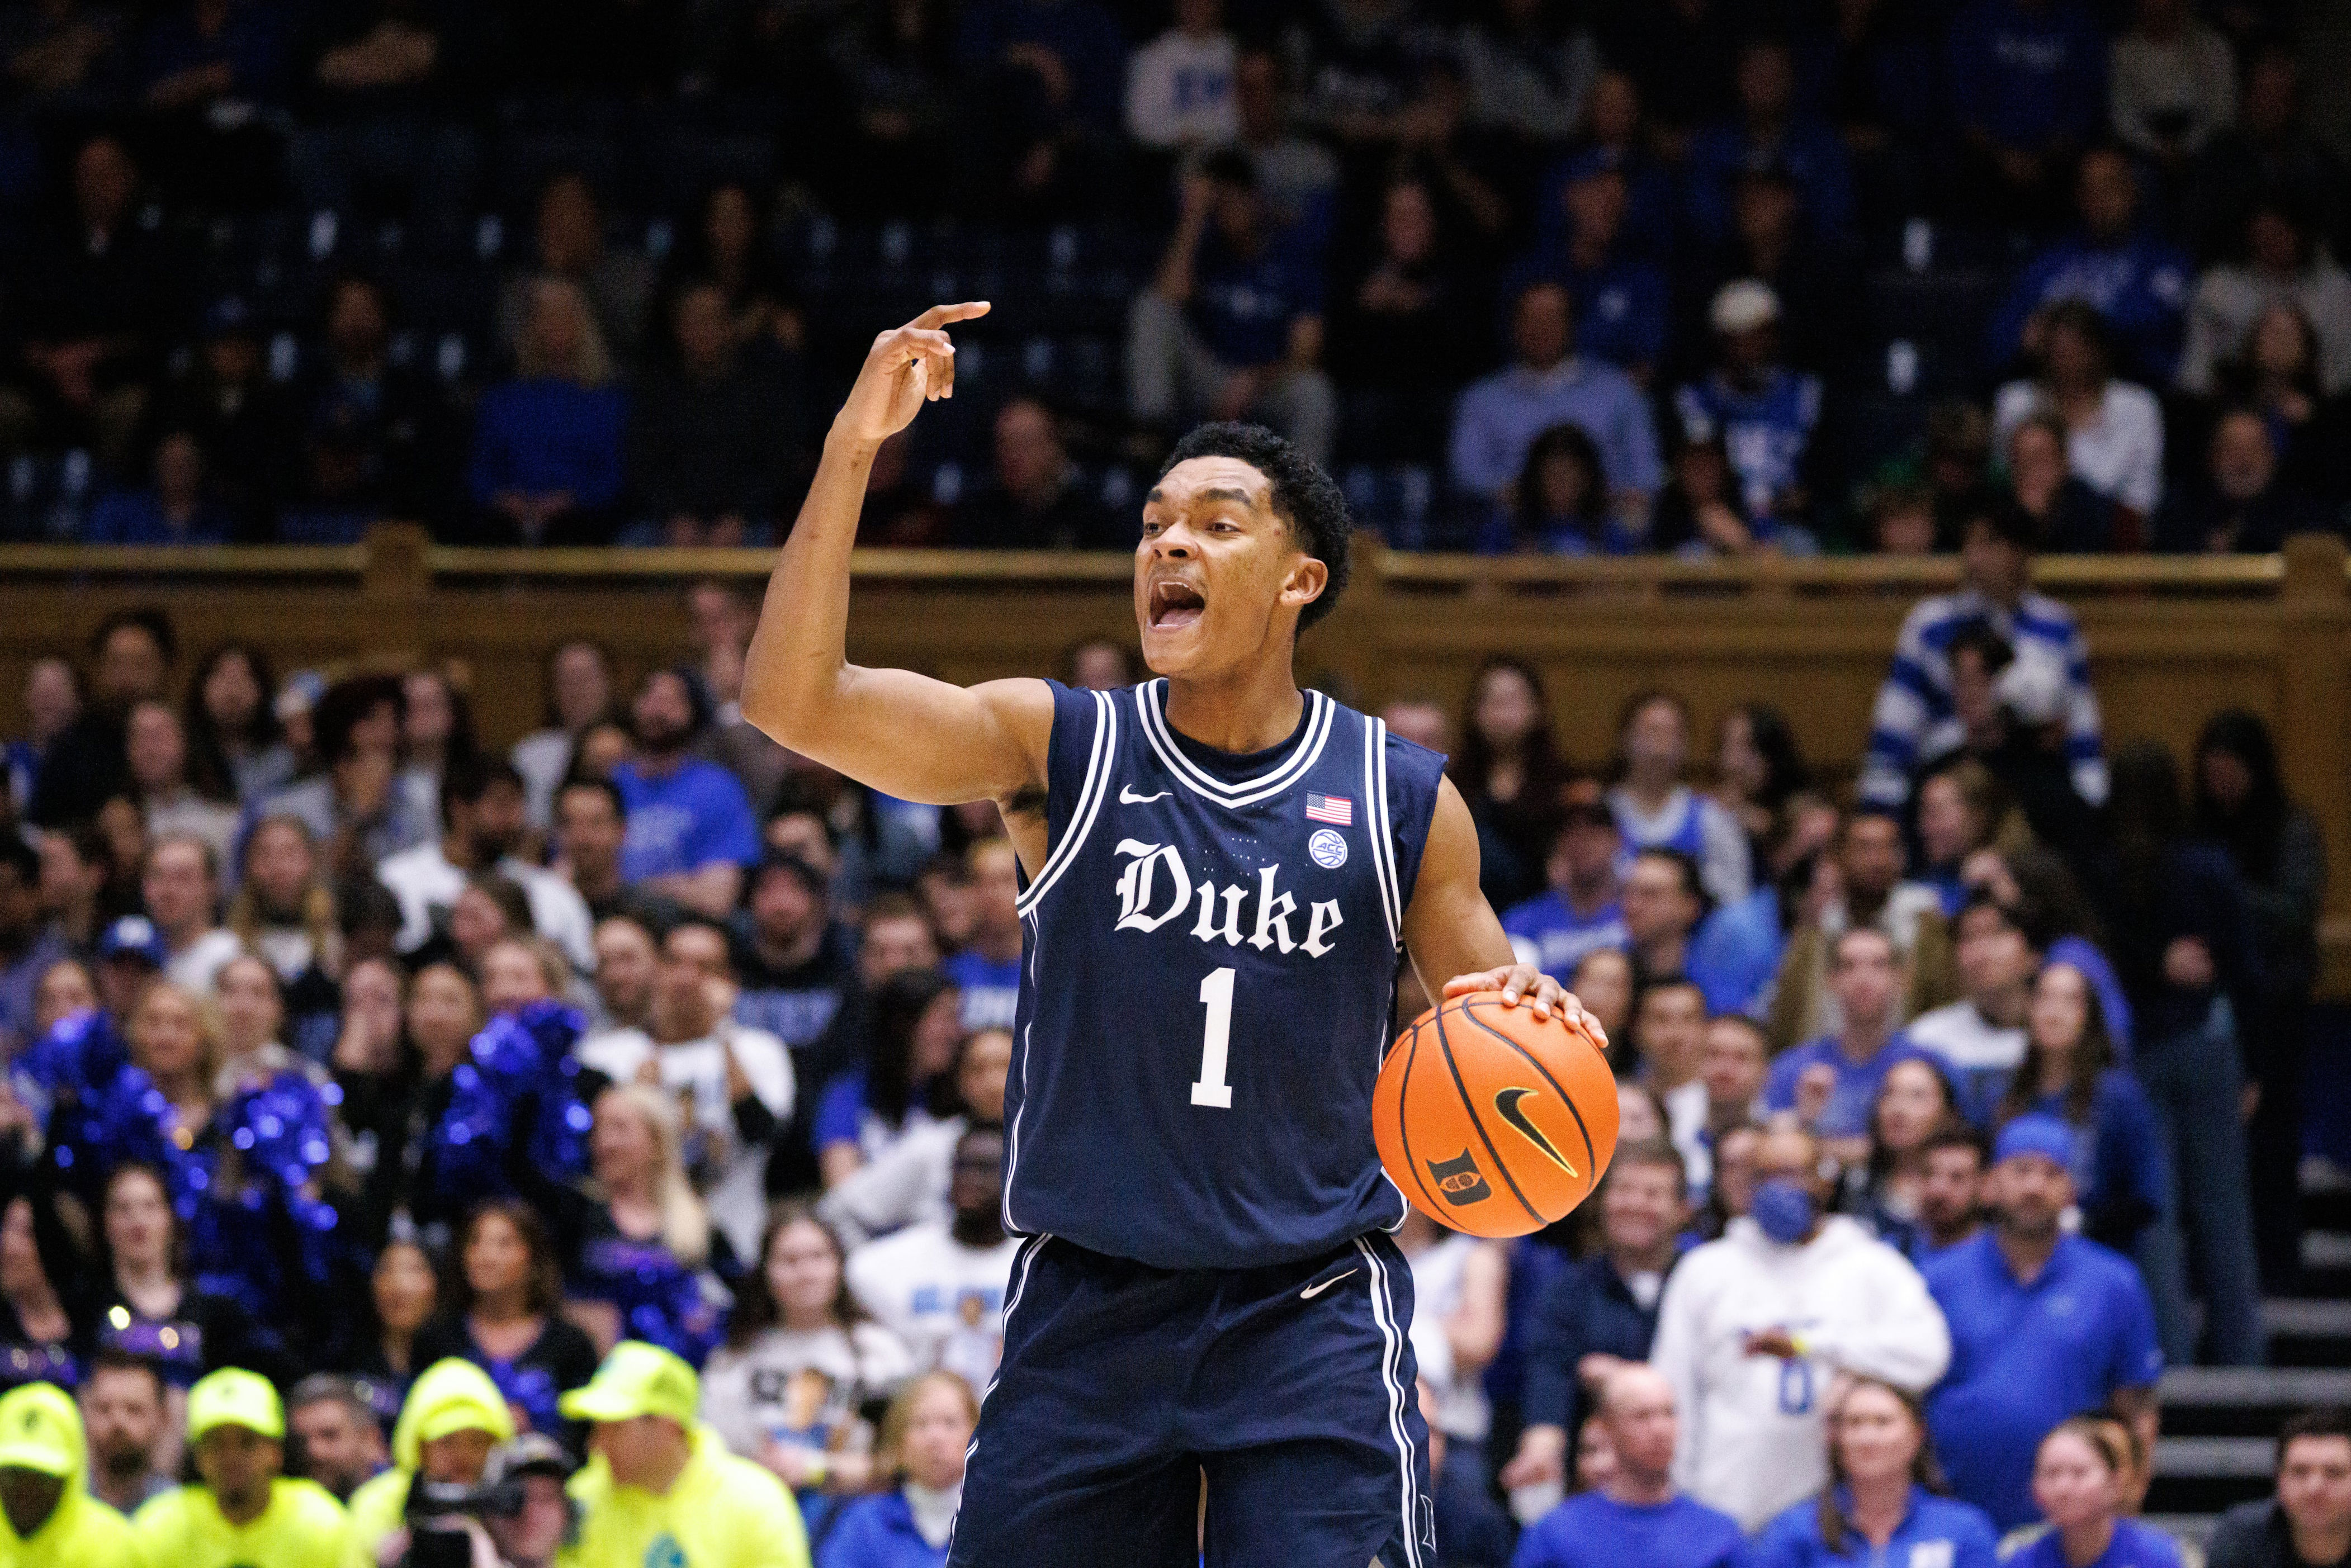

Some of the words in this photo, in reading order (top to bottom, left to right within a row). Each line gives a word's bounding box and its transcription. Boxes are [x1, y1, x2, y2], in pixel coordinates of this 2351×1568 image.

[1114, 838, 1344, 959] Duke
[1316, 842, 1345, 854] ACC
[1190, 967, 1236, 1109] 1
